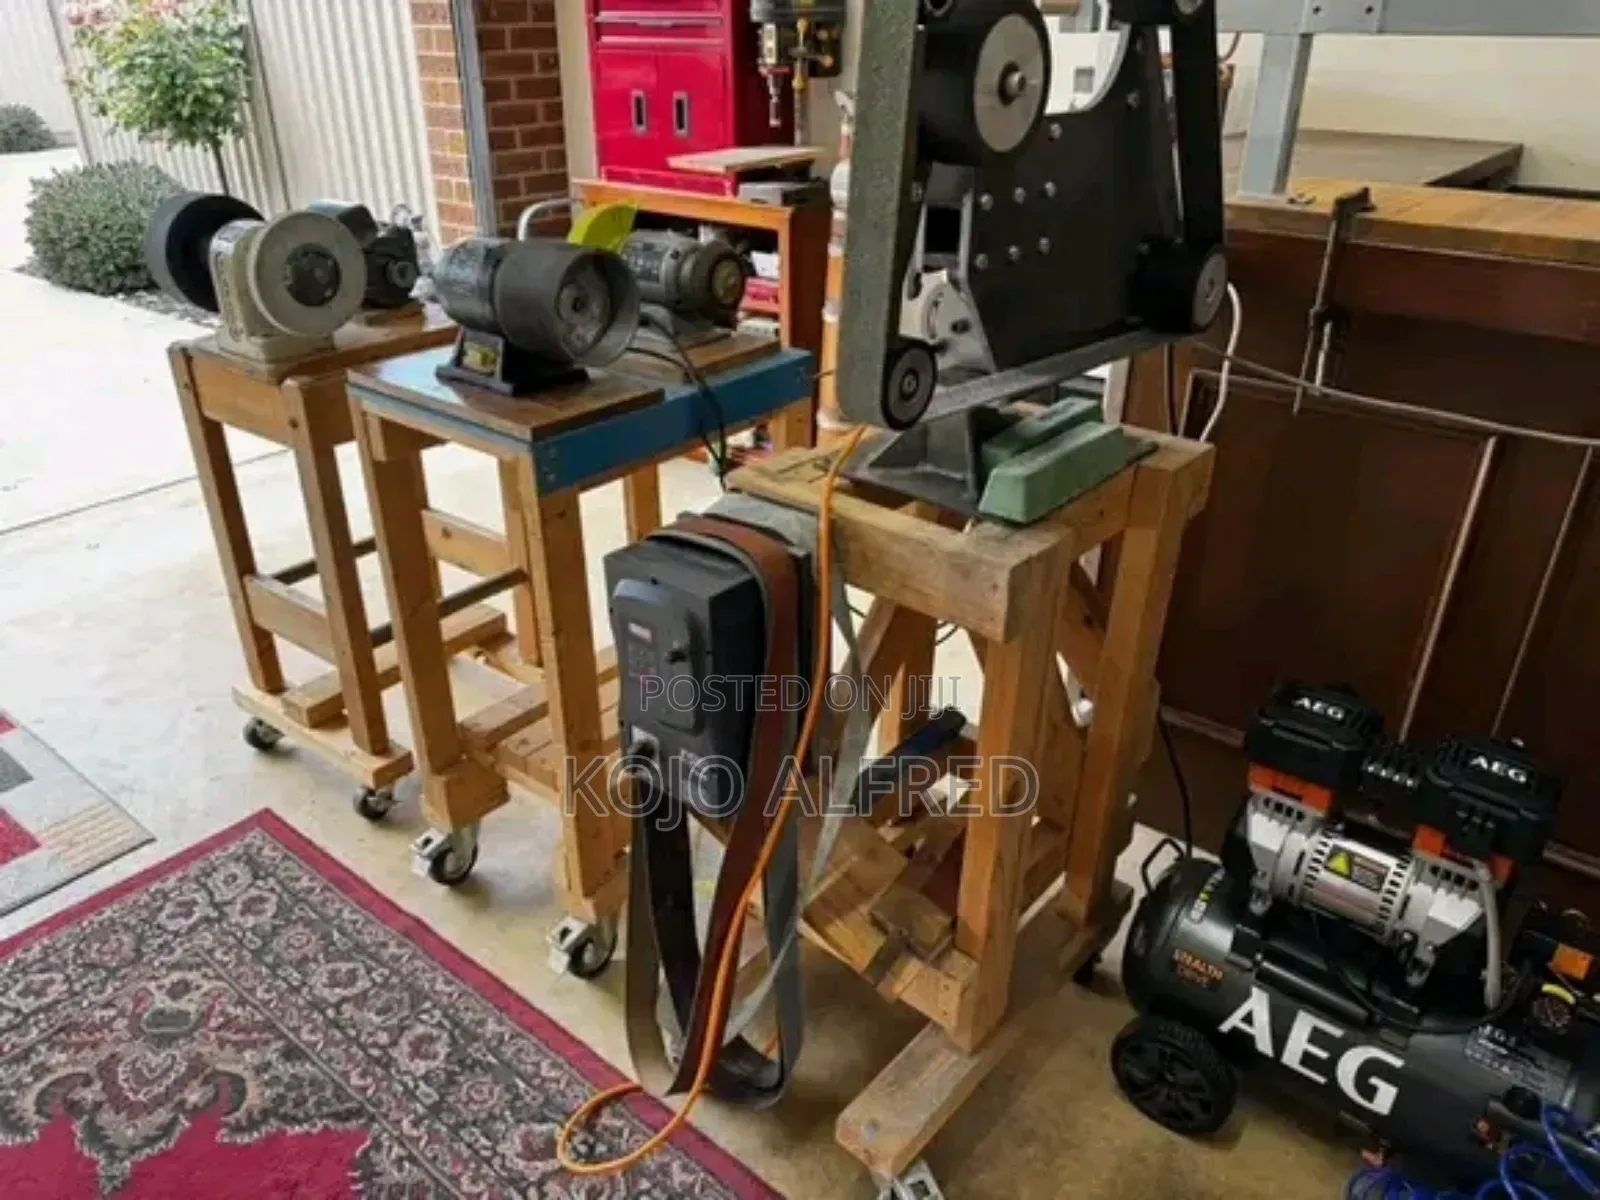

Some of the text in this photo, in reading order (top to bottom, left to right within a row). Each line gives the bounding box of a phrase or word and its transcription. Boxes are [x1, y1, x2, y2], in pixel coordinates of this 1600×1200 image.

[1294, 697, 1345, 721] AEG
[1470, 755, 1528, 784] AEG
[1217, 984, 1405, 1116] AEG
